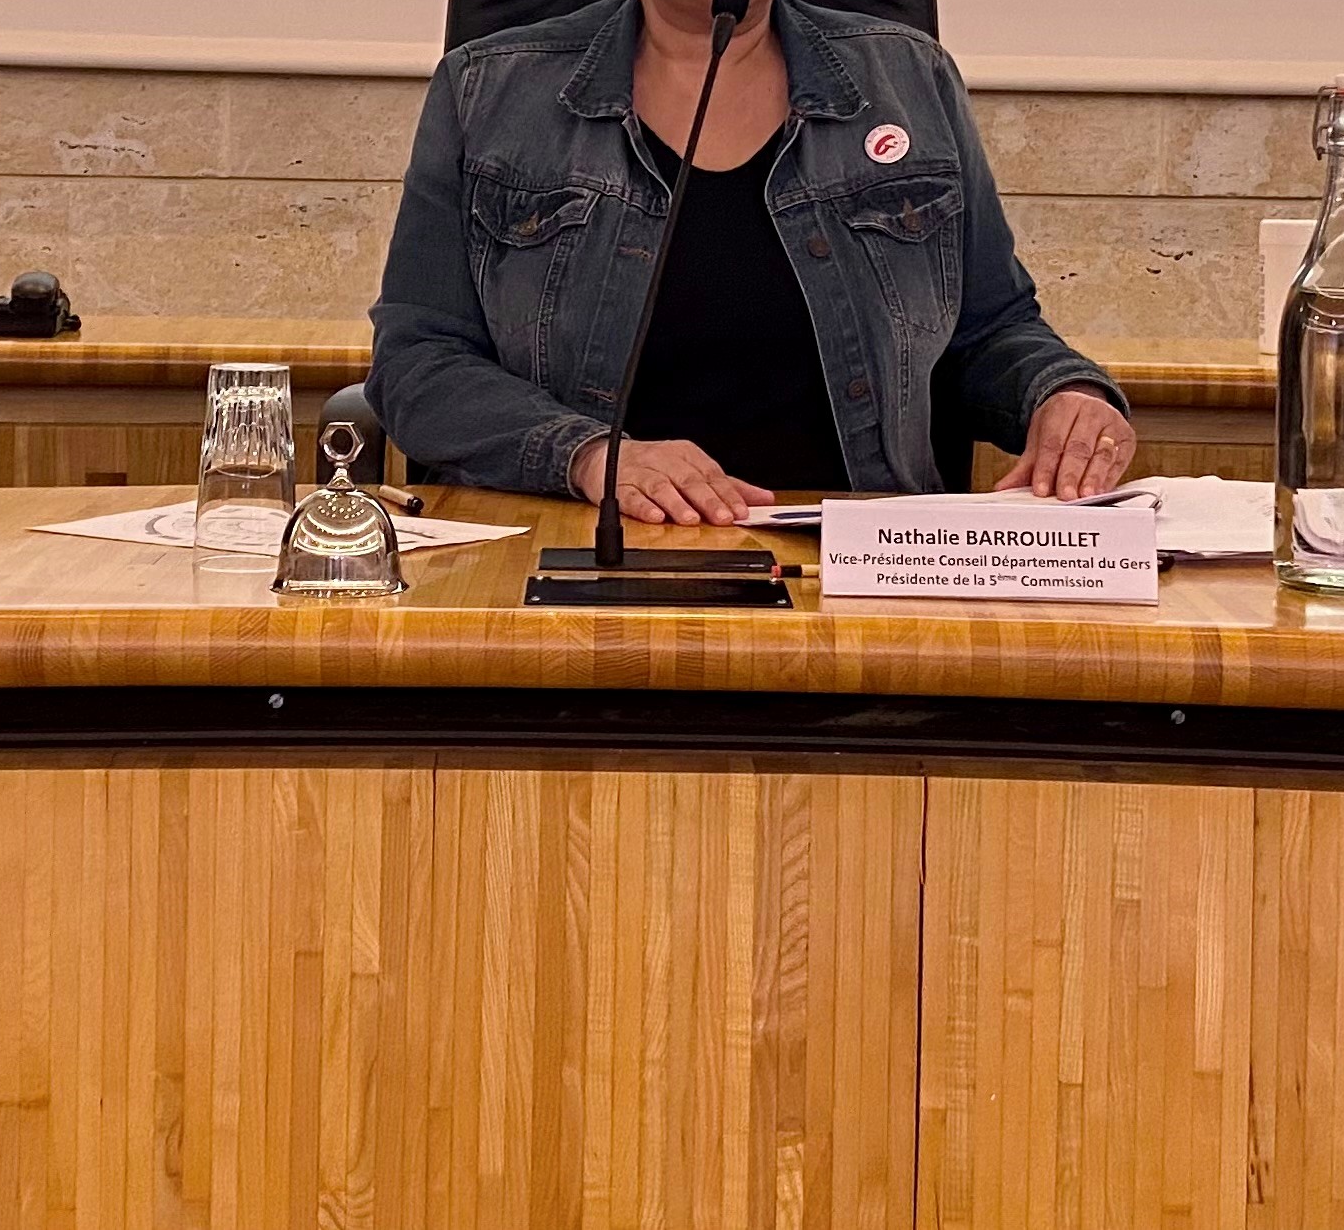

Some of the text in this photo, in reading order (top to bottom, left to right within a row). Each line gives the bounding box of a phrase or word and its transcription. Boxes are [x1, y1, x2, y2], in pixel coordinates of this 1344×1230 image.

[878, 528, 1100, 548] Nathalie BARROUILLET
[828, 552, 1152, 571] Vice-Présidente Conseil Départemental du Gers
[876, 571, 950, 586] Présidente
[952, 572, 971, 587] de
[973, 573, 986, 587] la
[1020, 574, 1105, 589] Commission
